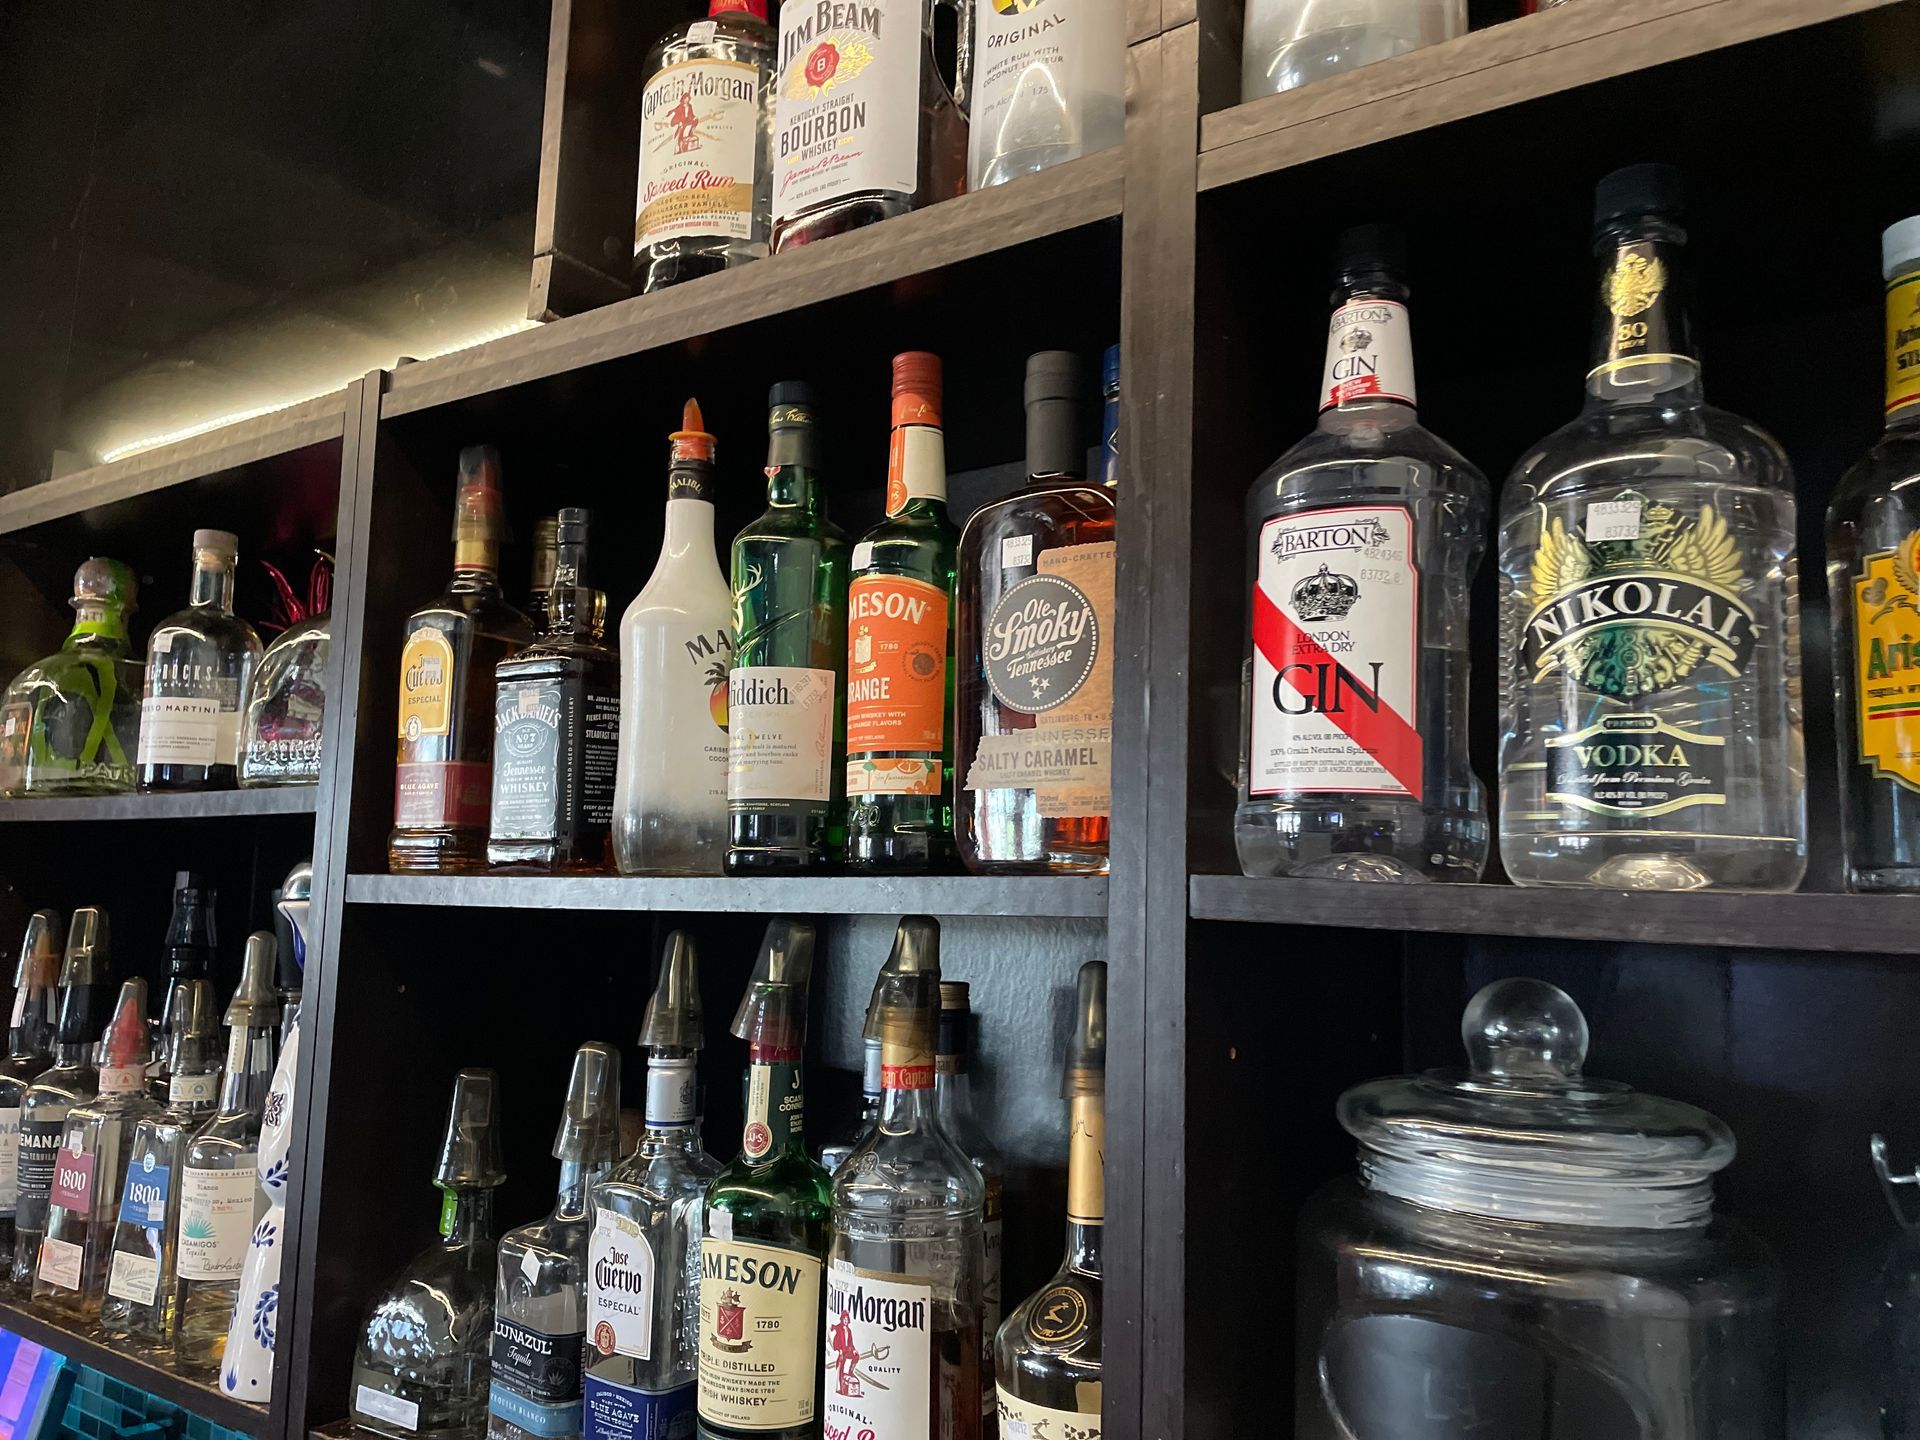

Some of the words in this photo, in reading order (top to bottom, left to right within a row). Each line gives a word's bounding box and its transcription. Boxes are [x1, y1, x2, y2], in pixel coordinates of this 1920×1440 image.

[780, 15, 814, 78] JIM
[816, 0, 881, 40] BEAM
[987, 14, 1066, 48] ORIGINAL
[817, 57, 827, 72] B
[987, 57, 1009, 75] WHITE
[1011, 51, 1031, 62] RUM
[1034, 46, 1060, 56] WITH
[983, 63, 1019, 88] COCONUT
[644, 76, 685, 120] Captain
[687, 71, 753, 104] Morgan
[790, 105, 820, 126] KENTUCKY
[822, 93, 855, 112] STRAIGHT
[781, 102, 866, 158] BOURBON
[801, 138, 838, 161] WHISKEY
[663, 160, 705, 174] ORIGINAL
[643, 171, 689, 203] Spiced
[690, 169, 737, 190] Rum
[1335, 309, 1383, 327] BARTON
[1617, 321, 1649, 341] 80
[1332, 354, 1379, 380] GIN
[670, 477, 703, 495] MALIBU
[1284, 526, 1370, 552] BARTON
[1024, 599, 1057, 623] Ole
[1532, 581, 1743, 649] NIKOLAI
[989, 602, 1092, 662] Smoky
[1297, 630, 1351, 644] LONDON
[880, 642, 899, 651] 1780
[1292, 641, 1328, 655] EXTRA
[1331, 640, 1356, 654] DRY
[162, 663, 213, 683] ROCKS
[1007, 649, 1073, 679] Tennessee
[730, 677, 790, 708] fiddich
[848, 676, 892, 704] RANGE
[1273, 661, 1384, 716] GIN
[165, 703, 217, 715] MARTINI
[408, 695, 442, 705] ESPECIAL
[495, 704, 520, 735] JACK
[872, 719, 903, 727] FLAVORS
[1605, 719, 1654, 728] PREMIUM
[748, 733, 783, 741] TWELVE
[1016, 727, 1111, 744] TENNESSE
[704, 745, 729, 754] CARIBBE
[978, 751, 1020, 772] SALTY
[1024, 747, 1098, 769] CARAMEL
[1310, 746, 1345, 755] Neutral
[1573, 744, 1690, 769] VODKA
[503, 761, 547, 777] Tennessee
[1622, 771, 1676, 785] Premium
[417, 782, 439, 790] AGAVE
[500, 781, 550, 795] WHISKEY
[882, 1071, 898, 1087] gan
[20, 1134, 62, 1149] EMANA
[29, 1151, 57, 1161] TEQUILA
[59, 1167, 87, 1192] 1800
[129, 1181, 160, 1205] 1800
[181, 1241, 218, 1249] CASAMIGOS
[608, 1246, 629, 1267] Jose
[595, 1256, 642, 1295] Cuervo
[701, 1252, 803, 1295] AMESON
[598, 1296, 640, 1316] ESPECIAL
[849, 1285, 925, 1333] Morgan
[756, 1320, 781, 1330] 1780
[495, 1321, 553, 1356] LUNAZUL
[507, 1345, 533, 1368] Tequila
[700, 1349, 721, 1368] TRIPLE
[722, 1360, 776, 1374] DISTILLED
[868, 1365, 901, 1375] QUALITY
[721, 1376, 747, 1387] WHISKEY
[727, 1385, 739, 1393] WAY
[740, 1387, 759, 1395] SINCE
[490, 1392, 518, 1412] TEQUILA
[519, 1405, 547, 1425] BLANCO
[720, 1393, 768, 1407] WHISKEY
[590, 1400, 610, 1415] BLUE
[611, 1408, 640, 1424] AGAVE
[828, 1404, 870, 1426] ORIGINAL
